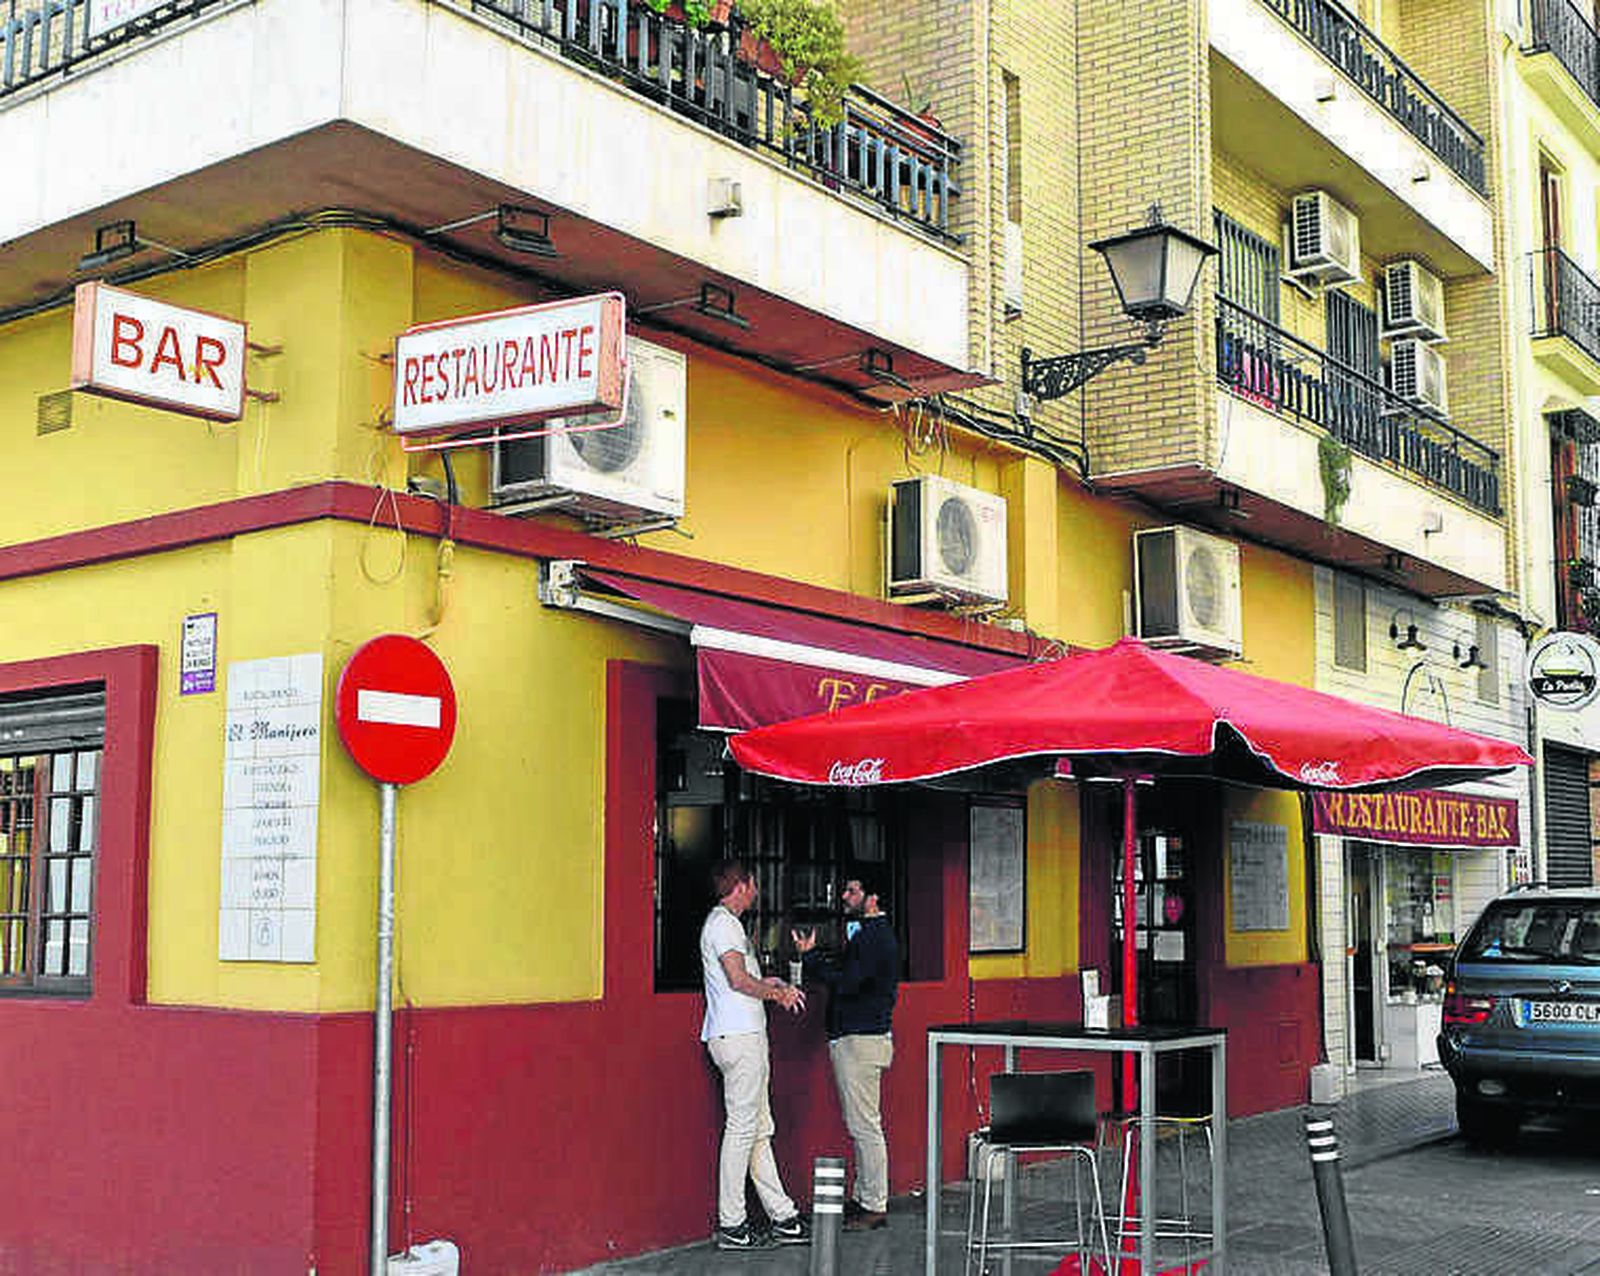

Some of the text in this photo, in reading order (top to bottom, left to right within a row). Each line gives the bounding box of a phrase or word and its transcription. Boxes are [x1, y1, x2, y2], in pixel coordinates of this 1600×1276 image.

[111, 312, 226, 391] BAR
[402, 325, 595, 408] RESTAURANTE
[1533, 1003, 1572, 1019] 5600
